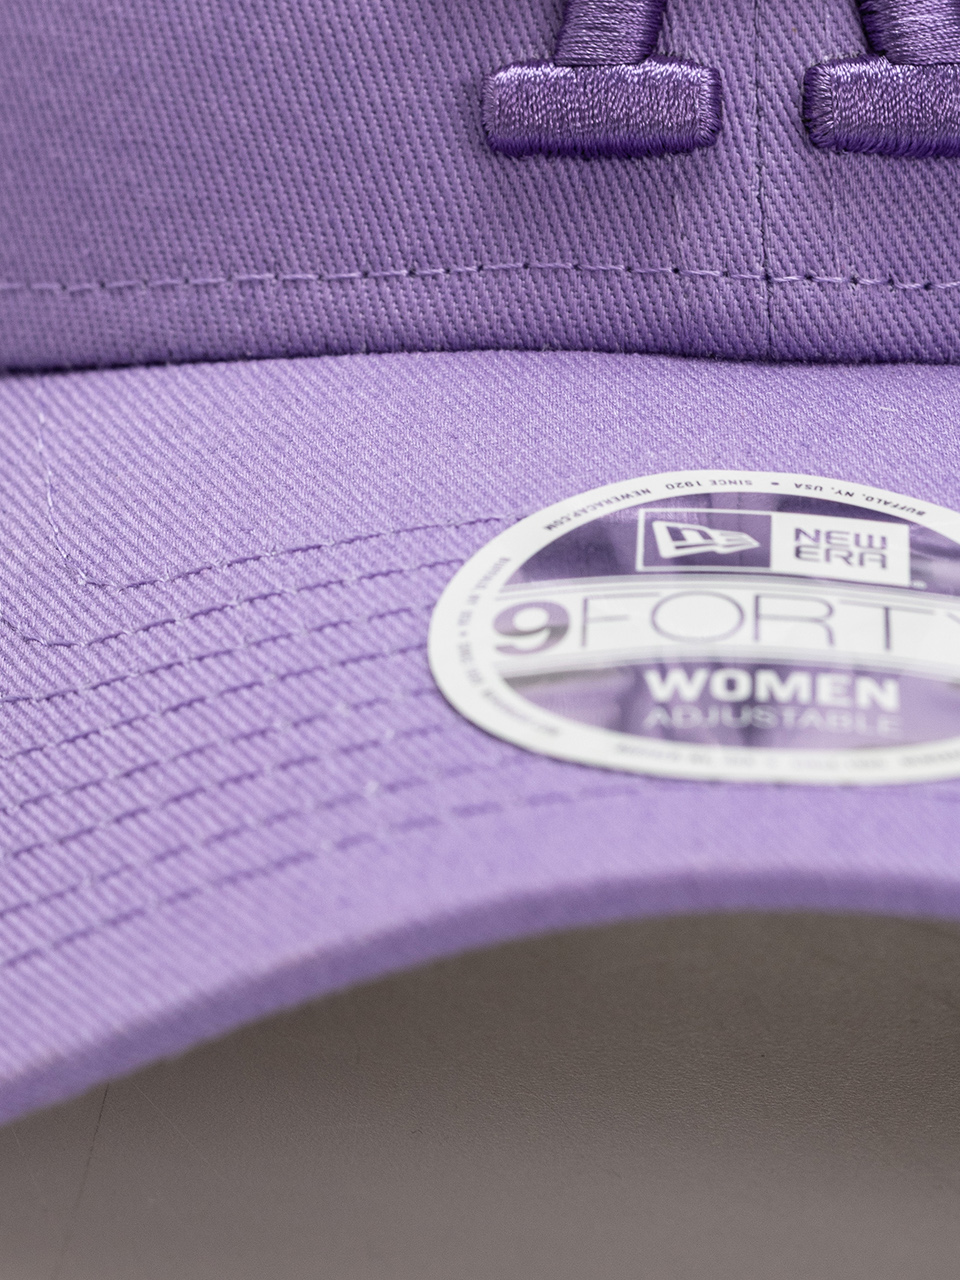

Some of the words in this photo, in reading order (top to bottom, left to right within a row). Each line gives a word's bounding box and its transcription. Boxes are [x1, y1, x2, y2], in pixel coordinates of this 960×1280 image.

[664, 480, 703, 491] 1920
[794, 482, 824, 492] USA
[794, 527, 888, 551] NEW
[794, 544, 888, 570] ERA
[642, 667, 901, 712] WOMEN
[642, 704, 904, 740] ADJUSTABLE
